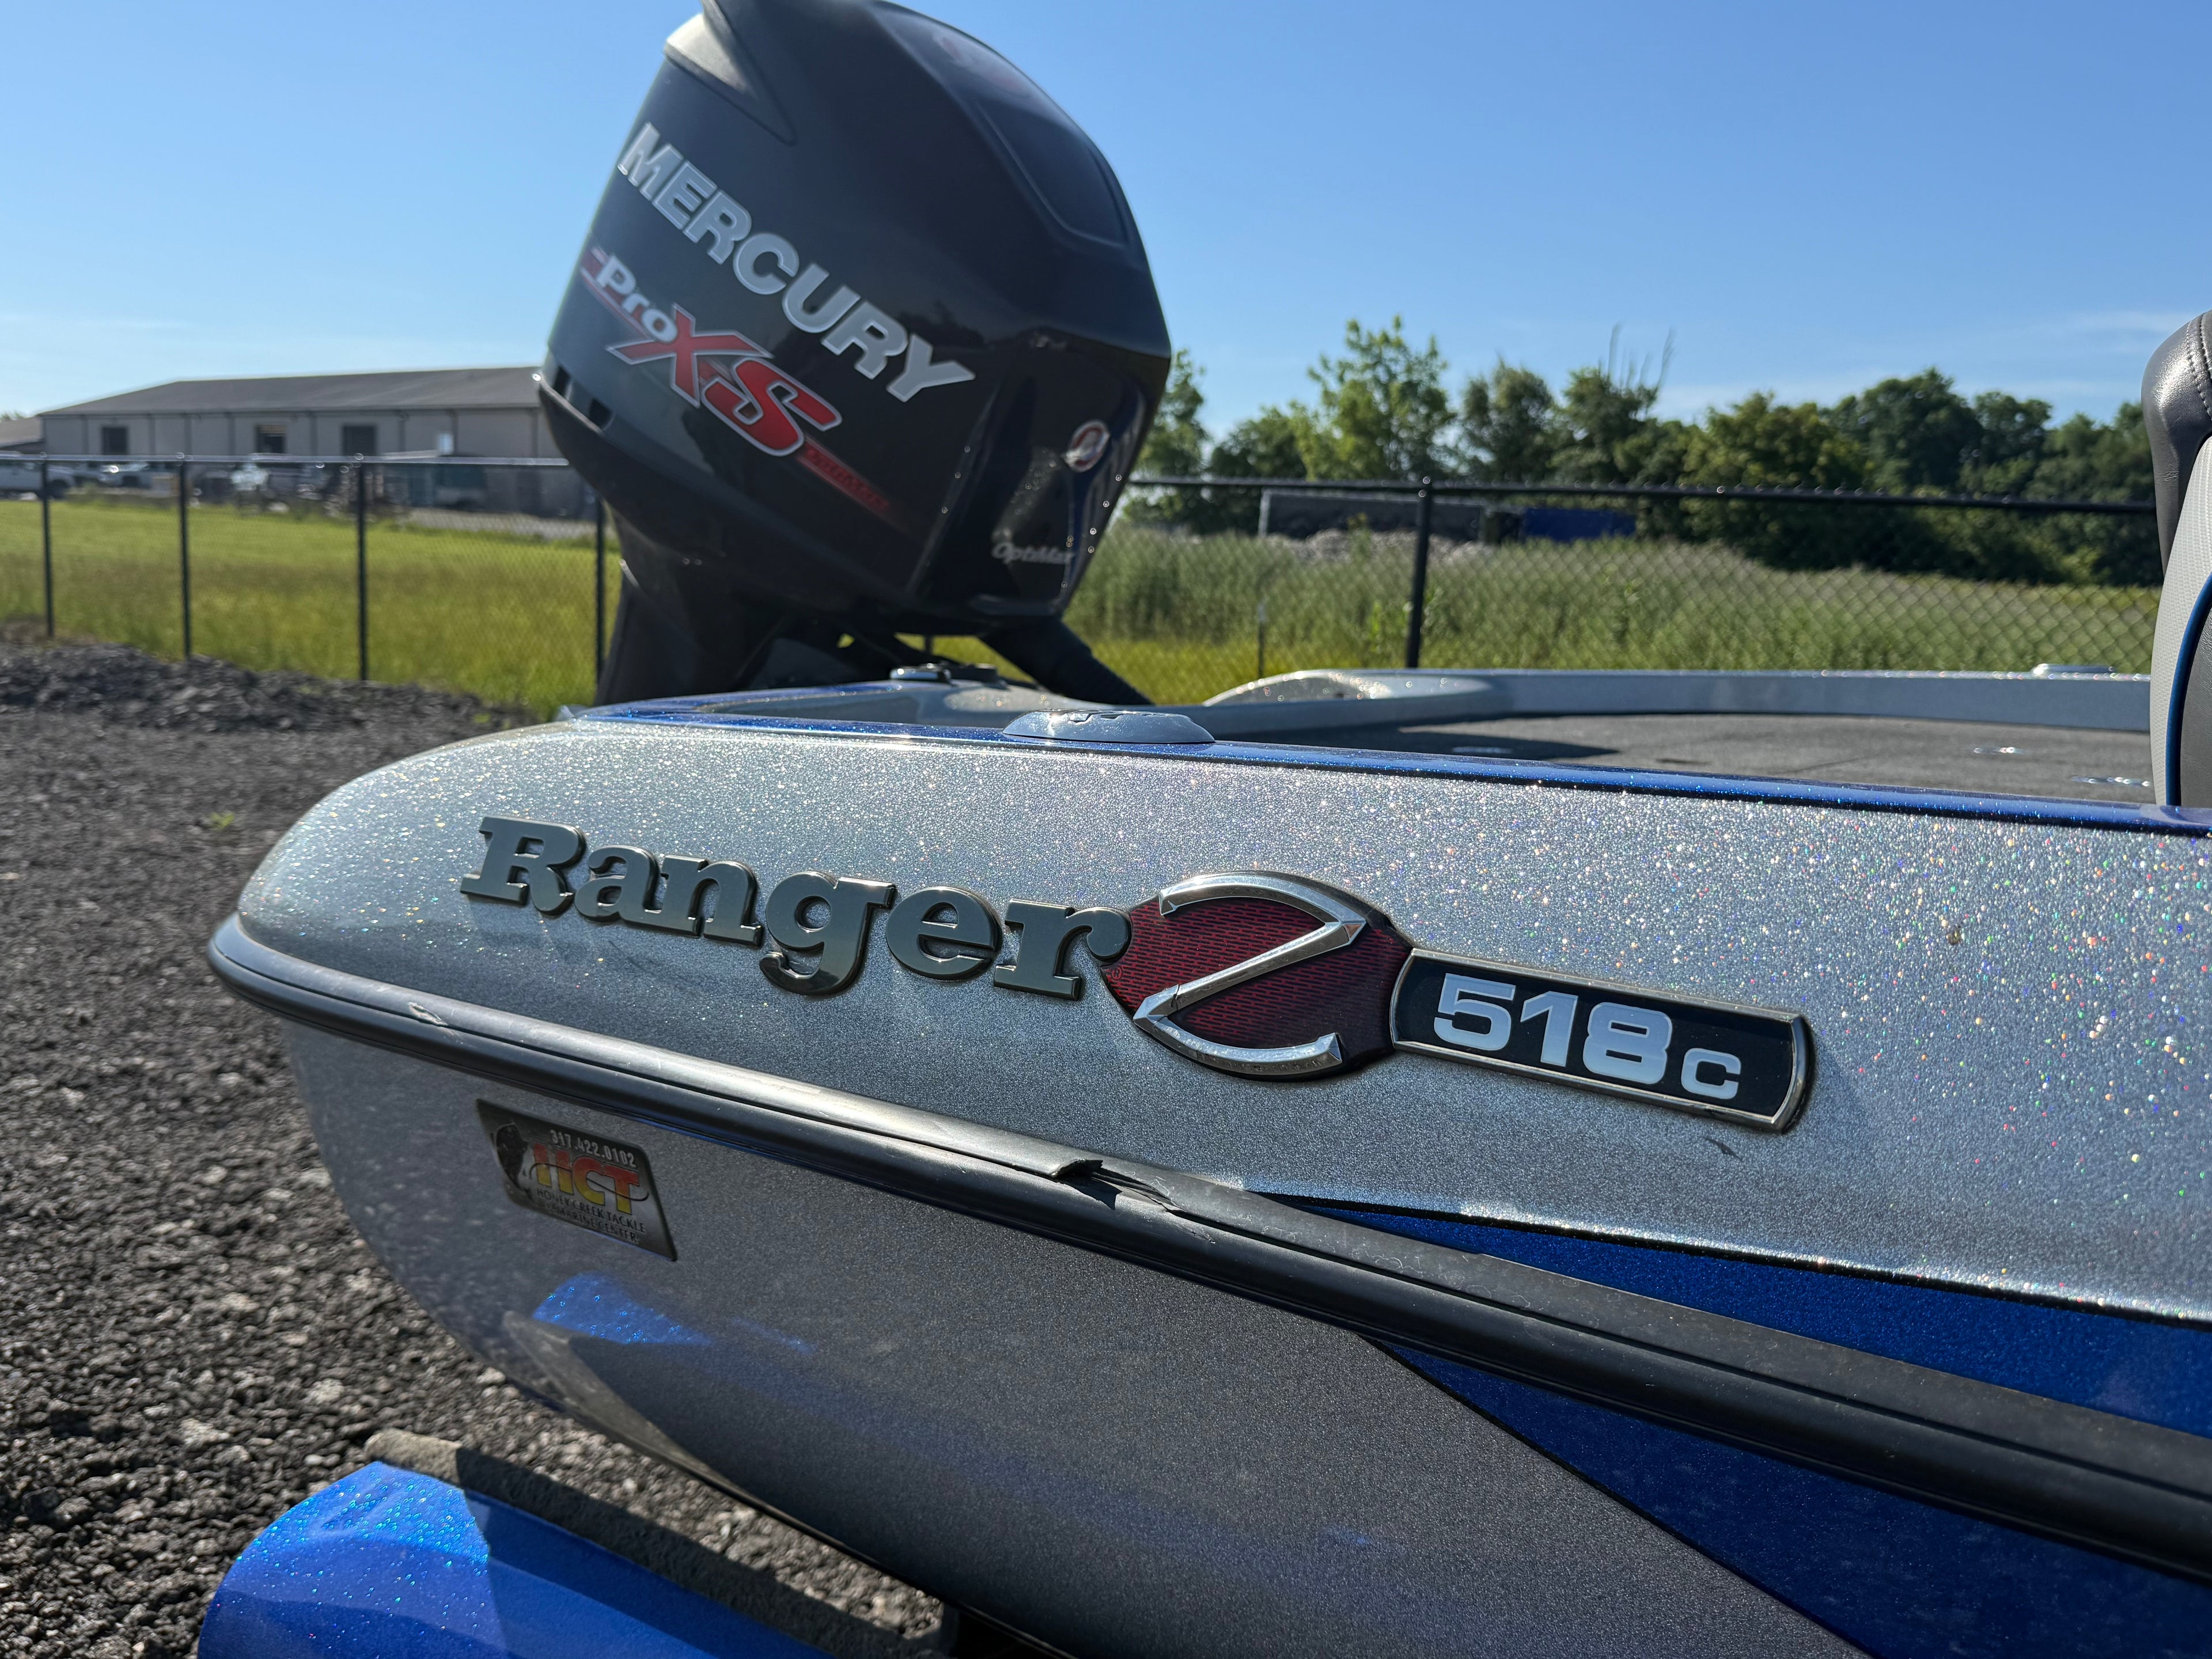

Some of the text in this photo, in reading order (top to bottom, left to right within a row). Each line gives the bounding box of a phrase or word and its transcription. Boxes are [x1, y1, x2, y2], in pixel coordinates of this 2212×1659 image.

[617, 122, 976, 402] MERCURY
[597, 252, 843, 457] Pro XS
[461, 816, 1133, 1001] Ranger
[533, 1142, 640, 1215] HCT
[549, 1128, 637, 1168] 317.422.0102
[536, 1187, 571, 1207] HONEY
[571, 1199, 604, 1219] CREEK
[606, 1211, 645, 1233] TACKLE
[596, 1220, 638, 1243] CENTER
